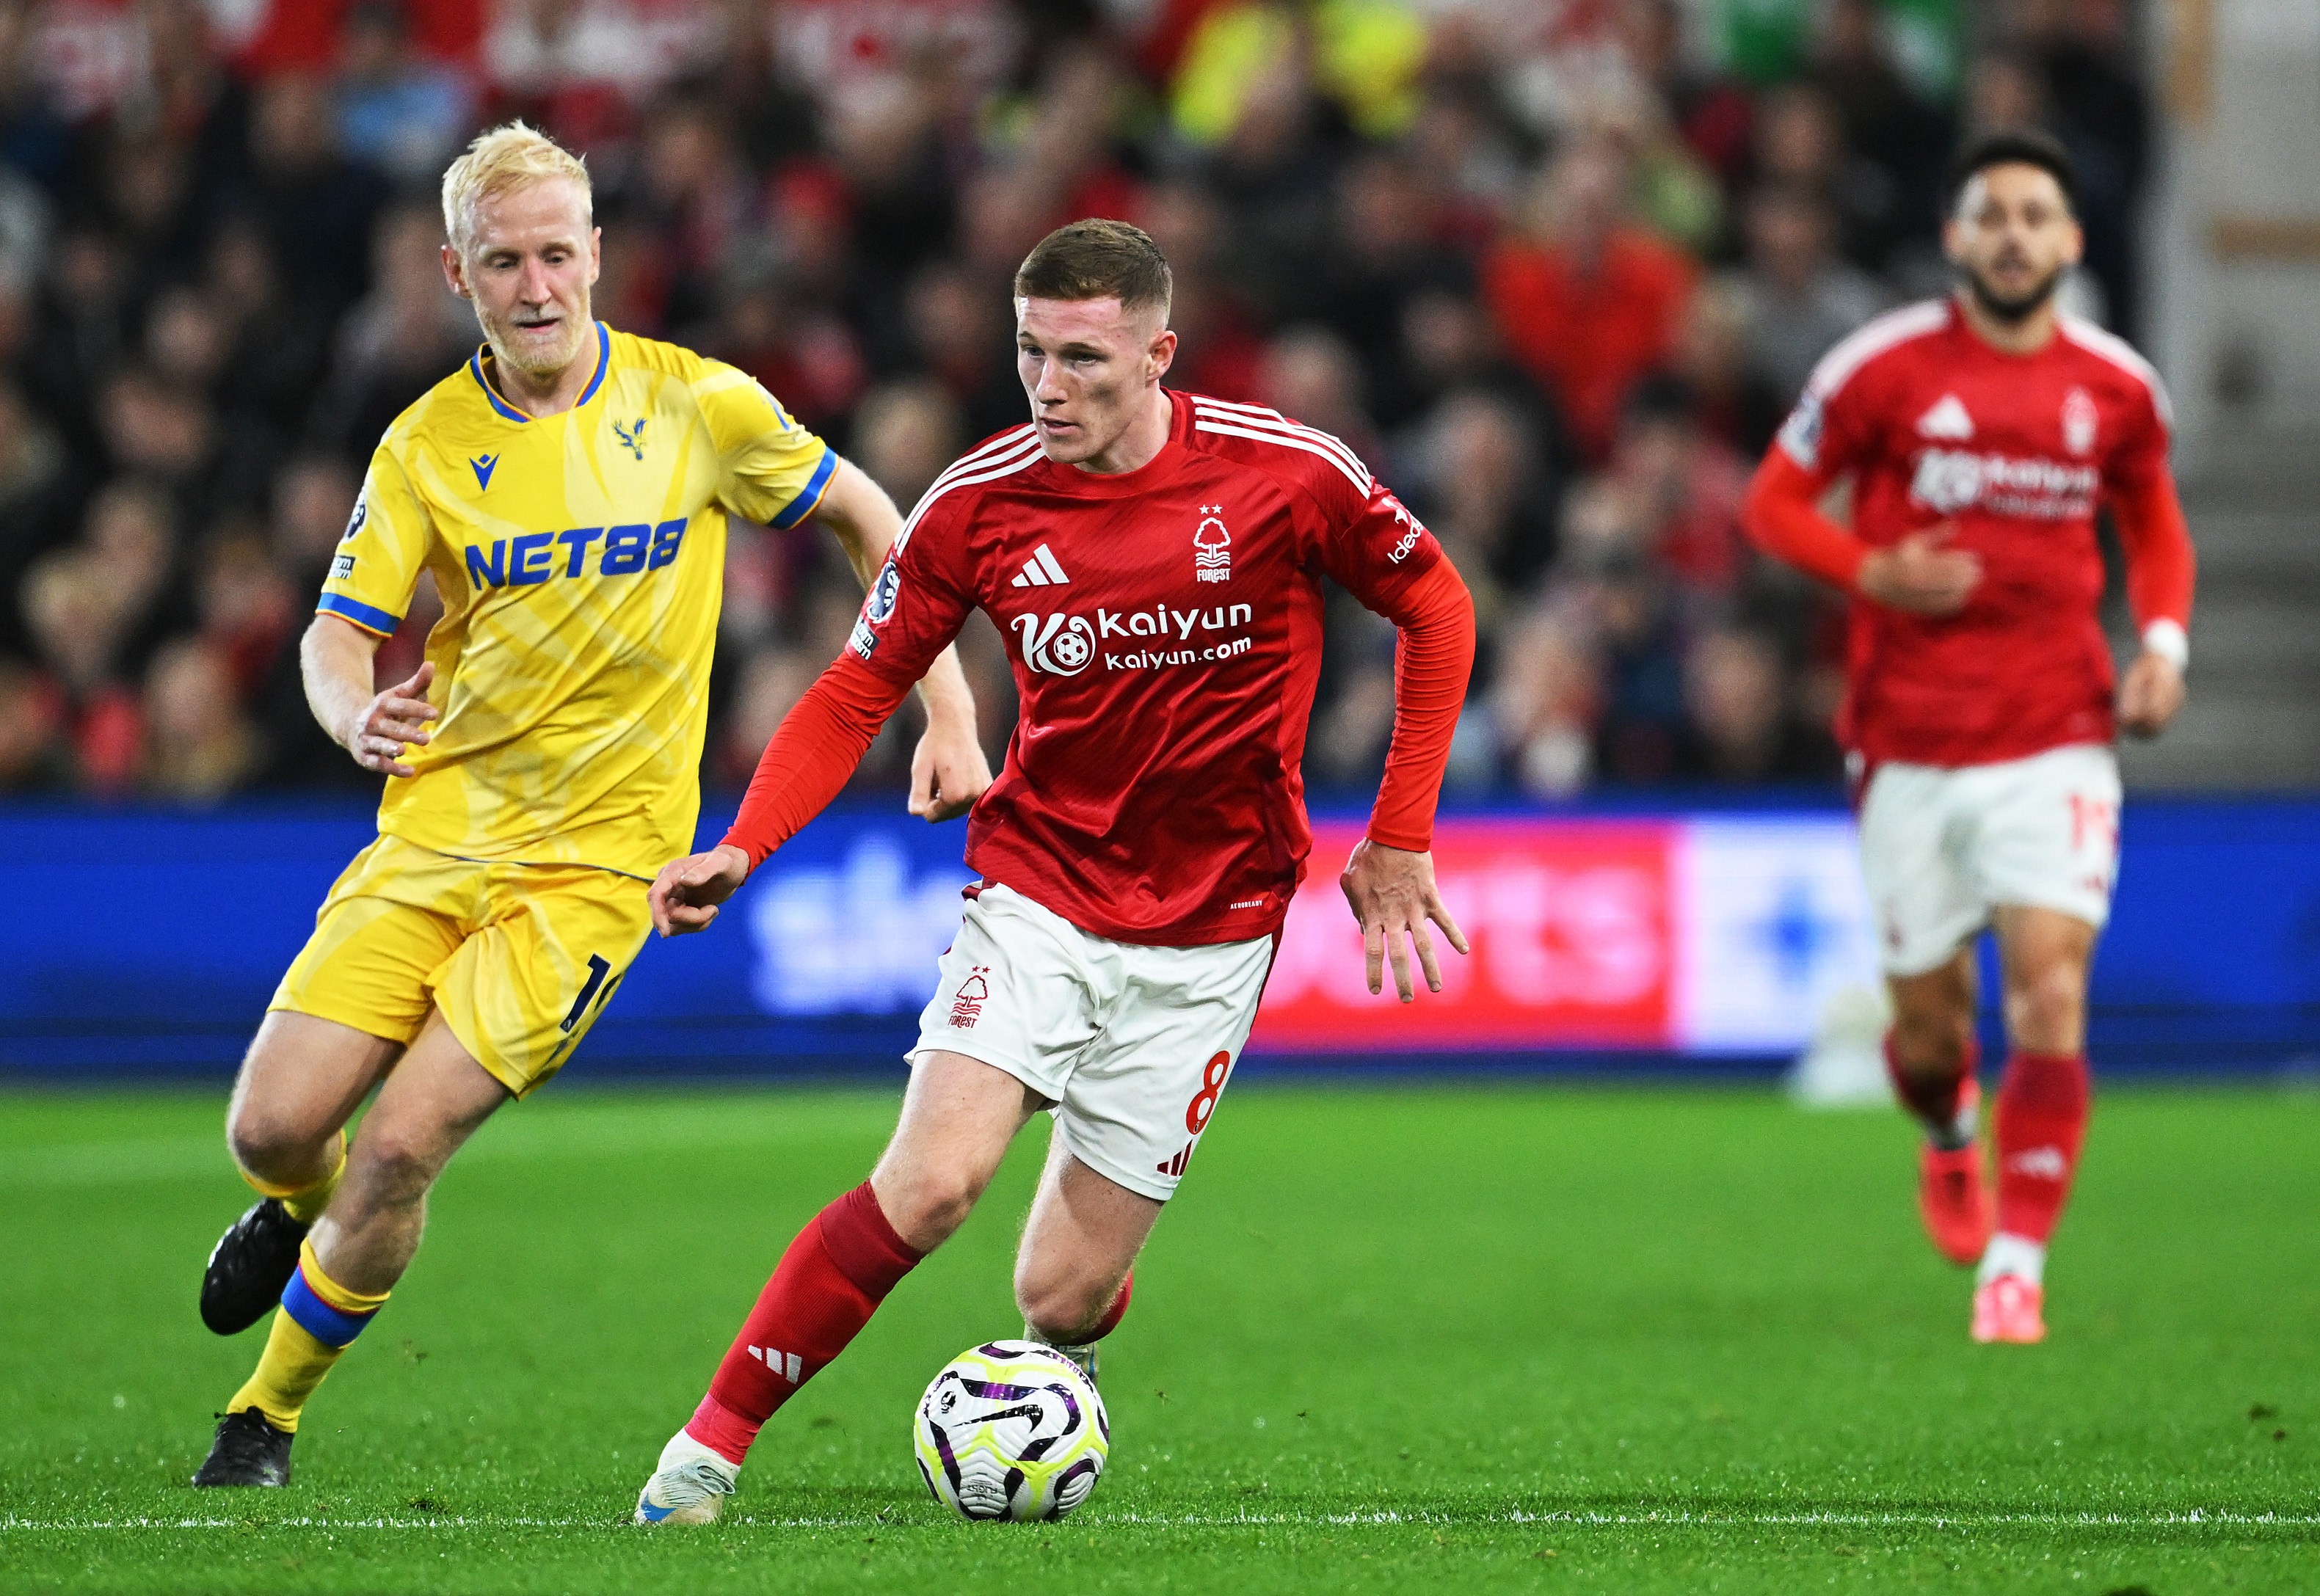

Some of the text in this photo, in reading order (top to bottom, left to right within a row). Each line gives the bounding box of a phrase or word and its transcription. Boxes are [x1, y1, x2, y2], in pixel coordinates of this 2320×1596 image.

[465, 517, 688, 590] NET88
[1196, 568, 1231, 583] FOREST
[1097, 603, 1252, 641] kaiyun
[1105, 636, 1252, 671] kaiyun.com
[1230, 900, 1262, 910] AEROREADY
[559, 952, 626, 1034] 1
[948, 1015, 978, 1029] FOREST
[1185, 1049, 1231, 1135] 8
